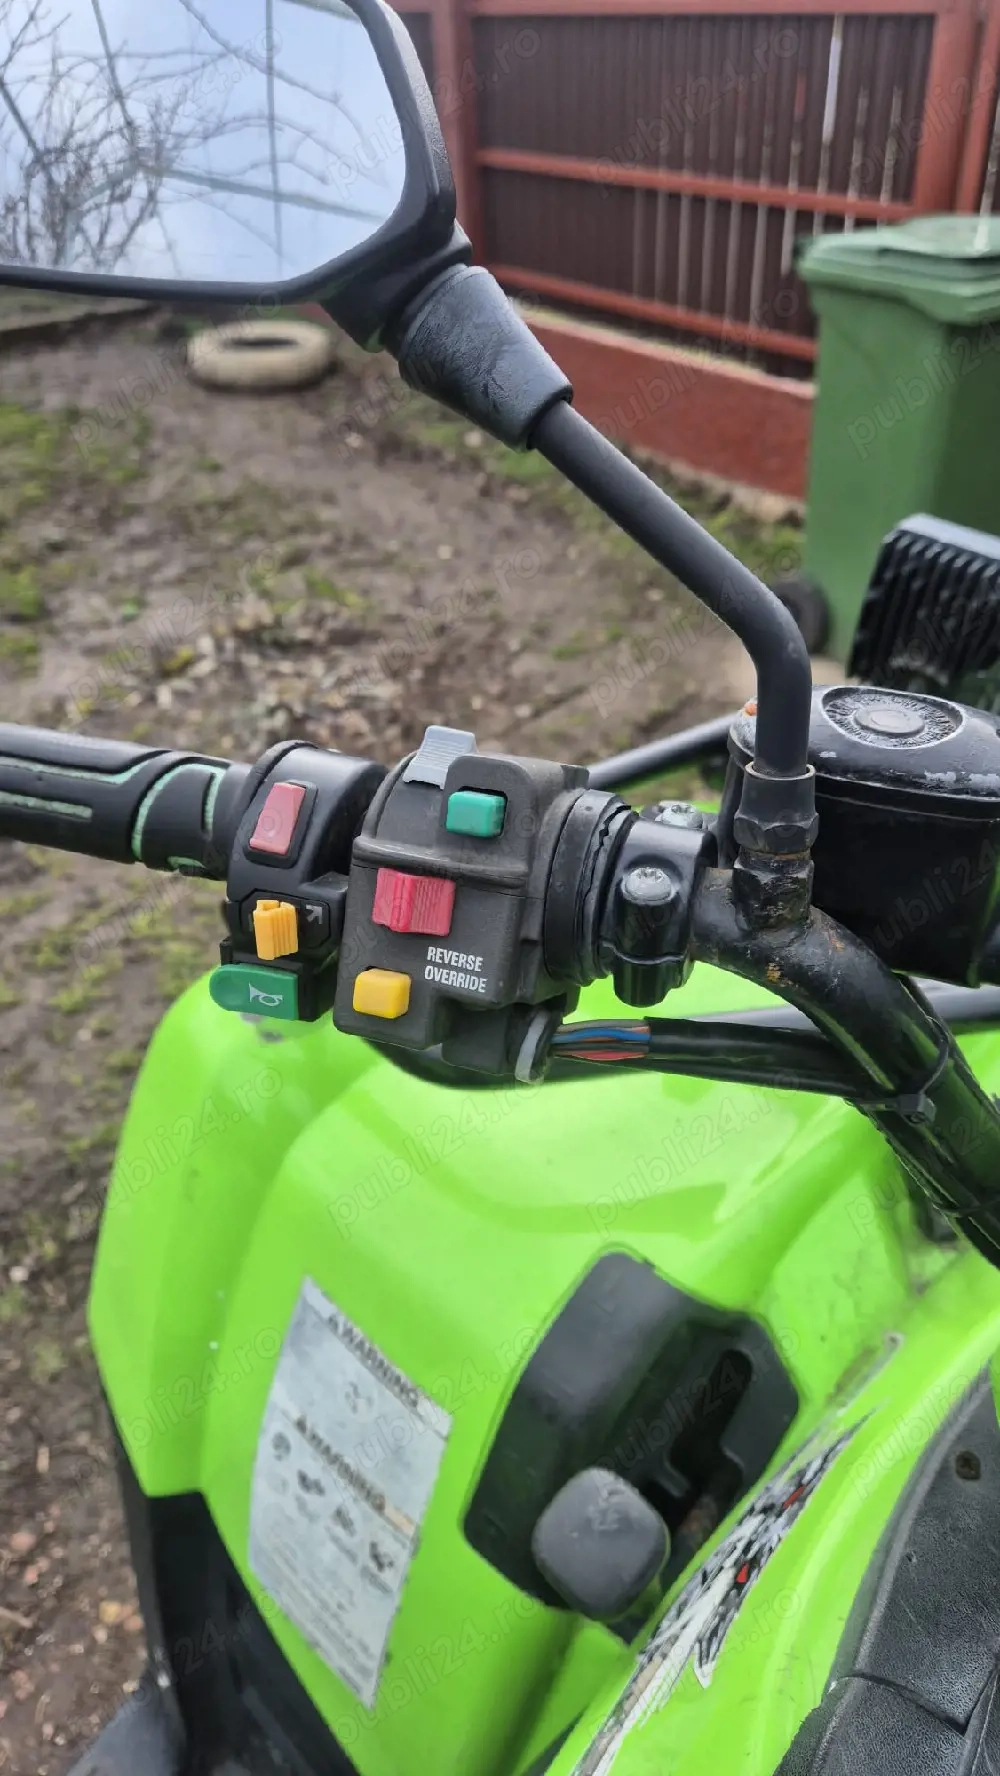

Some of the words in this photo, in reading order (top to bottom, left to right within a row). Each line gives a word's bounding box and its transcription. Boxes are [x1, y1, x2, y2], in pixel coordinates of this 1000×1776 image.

[427, 946, 484, 972] REVERSE
[424, 965, 488, 993] OVERRIDE
[342, 1321, 418, 1409] WARNING
